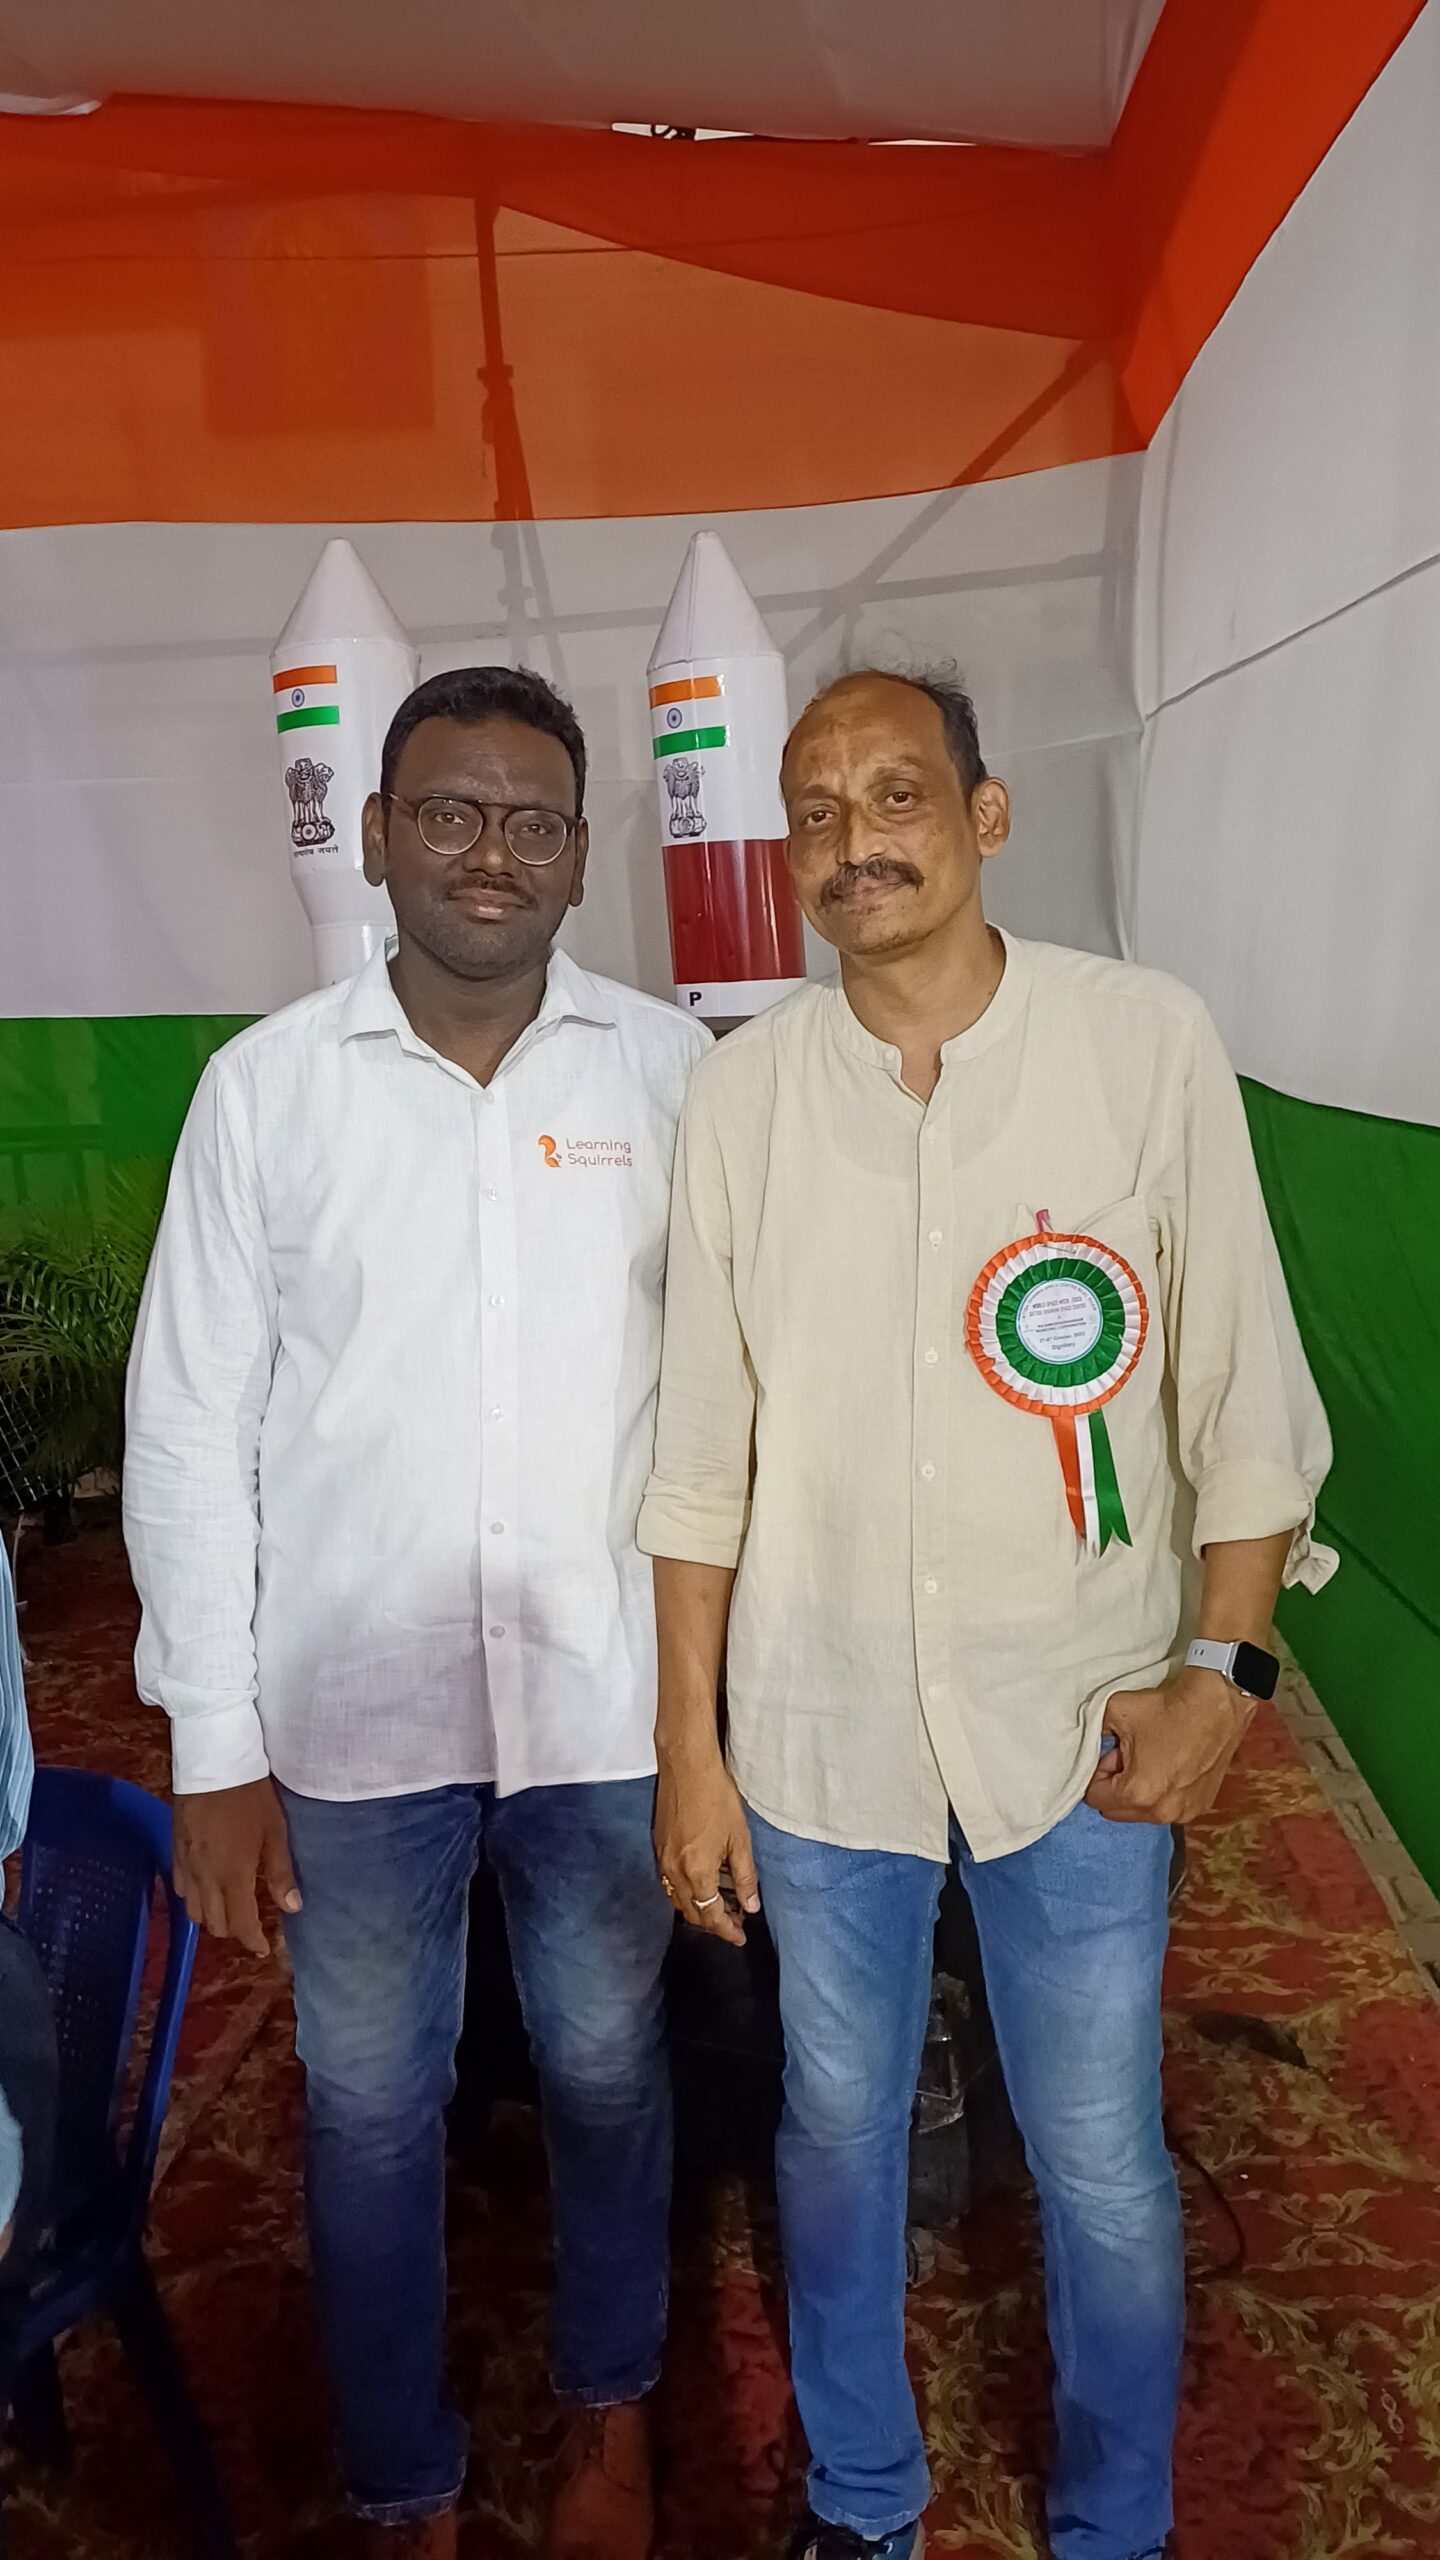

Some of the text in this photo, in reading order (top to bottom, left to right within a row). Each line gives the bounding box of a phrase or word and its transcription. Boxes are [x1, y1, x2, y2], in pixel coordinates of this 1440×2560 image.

[689, 991, 703, 1007] P
[566, 1138, 631, 1153] Learning
[567, 1153, 632, 1167] Squirrels
